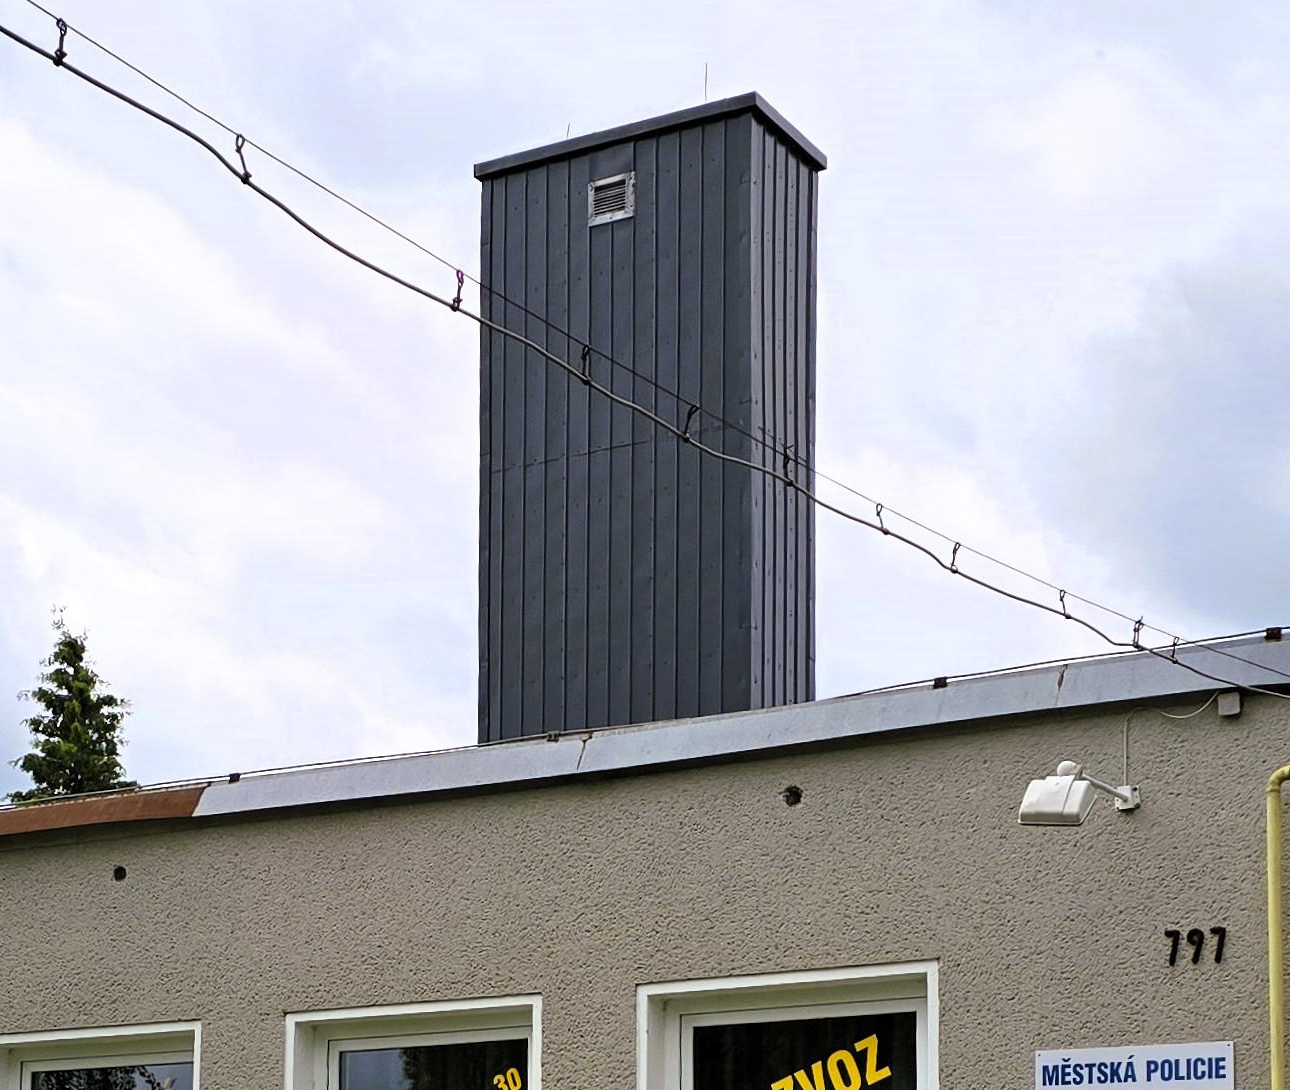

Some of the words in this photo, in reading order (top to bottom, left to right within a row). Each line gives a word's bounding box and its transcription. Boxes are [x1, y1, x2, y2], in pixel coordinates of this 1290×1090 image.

[1164, 926, 1227, 967] 797
[1042, 1055, 1137, 1086] MĚSTSKÁ
[1146, 1057, 1226, 1082] POLICIE
